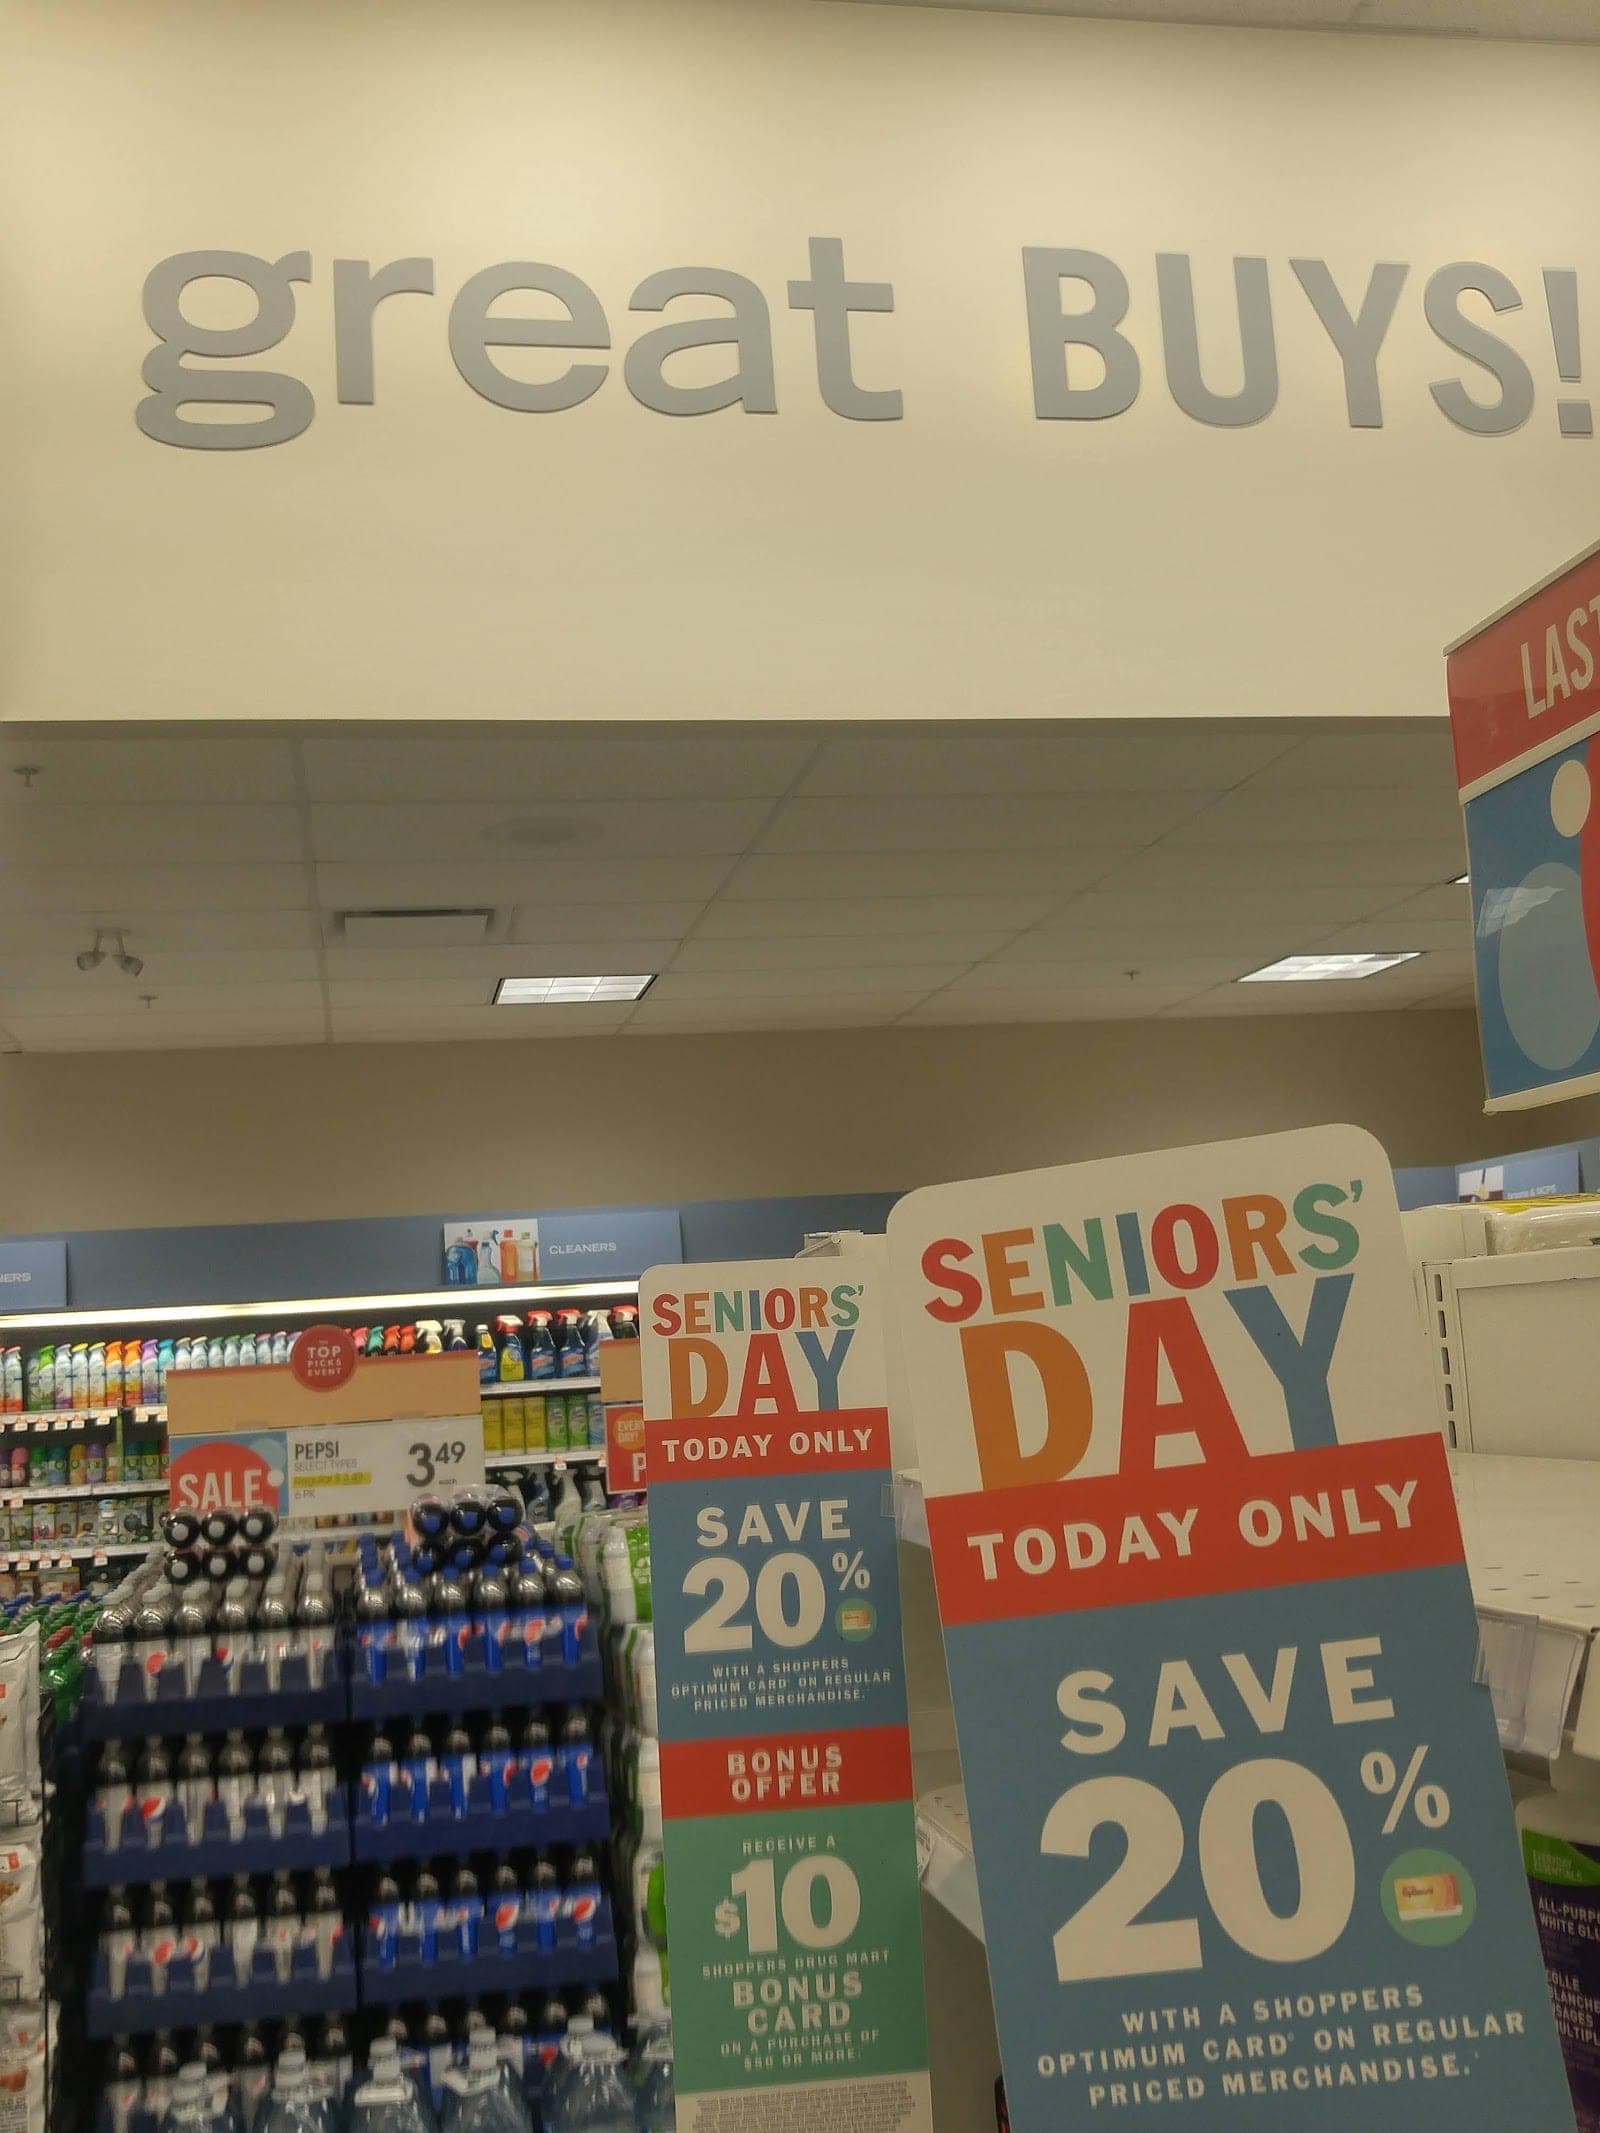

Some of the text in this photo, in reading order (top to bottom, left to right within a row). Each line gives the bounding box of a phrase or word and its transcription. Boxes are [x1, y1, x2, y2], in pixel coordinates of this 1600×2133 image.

[136, 236, 1594, 452] great BUYS!
[549, 1242, 617, 1255] CLEANERS
[921, 1180, 1363, 1324] SENIORS'
[652, 1285, 864, 1336] SENIORS'
[306, 1345, 342, 1359] TOP
[307, 1367, 342, 1377] EVENT
[668, 1329, 856, 1420] DAY
[960, 1273, 1355, 1492] DAY
[295, 1441, 339, 1460] PEPSI
[662, 1428, 872, 1463] TODAY ONLY
[295, 1460, 330, 1472] SELECT
[179, 1469, 264, 1510] SALE
[696, 1500, 850, 1547] SAVE
[967, 1480, 1418, 1580] TODAY ONLY
[671, 1682, 741, 1698] OPTIMUM
[799, 1676, 817, 1688] ON
[825, 1671, 891, 1686] REGULAR
[713, 1658, 849, 1678] WITH A SHOPPERS
[694, 1697, 747, 1714] PRICED
[1056, 1636, 1395, 1755] SAVE
[727, 1745, 843, 1777] BONUS
[731, 1771, 841, 1802] OFFER
[742, 1835, 836, 1856] RECEIVE A
[714, 1854, 861, 1953] $10
[1540, 1912, 1576, 1936] WHITE
[702, 1950, 890, 1977] SHOPPERS DRUG MART
[733, 1970, 863, 2008] BONUS
[747, 2000, 851, 2034] CARD
[1121, 1984, 1423, 2035] WITH A SHOPPERS
[720, 2029, 879, 2057] ON A PURCHASE OF
[782, 2053, 802, 2066] OR
[1037, 2042, 1186, 2078] OPTIMUM
[1314, 2025, 1356, 2051] ON
[1372, 2010, 1525, 2047] REGULAR
[1088, 2074, 1206, 2109] PRICED
